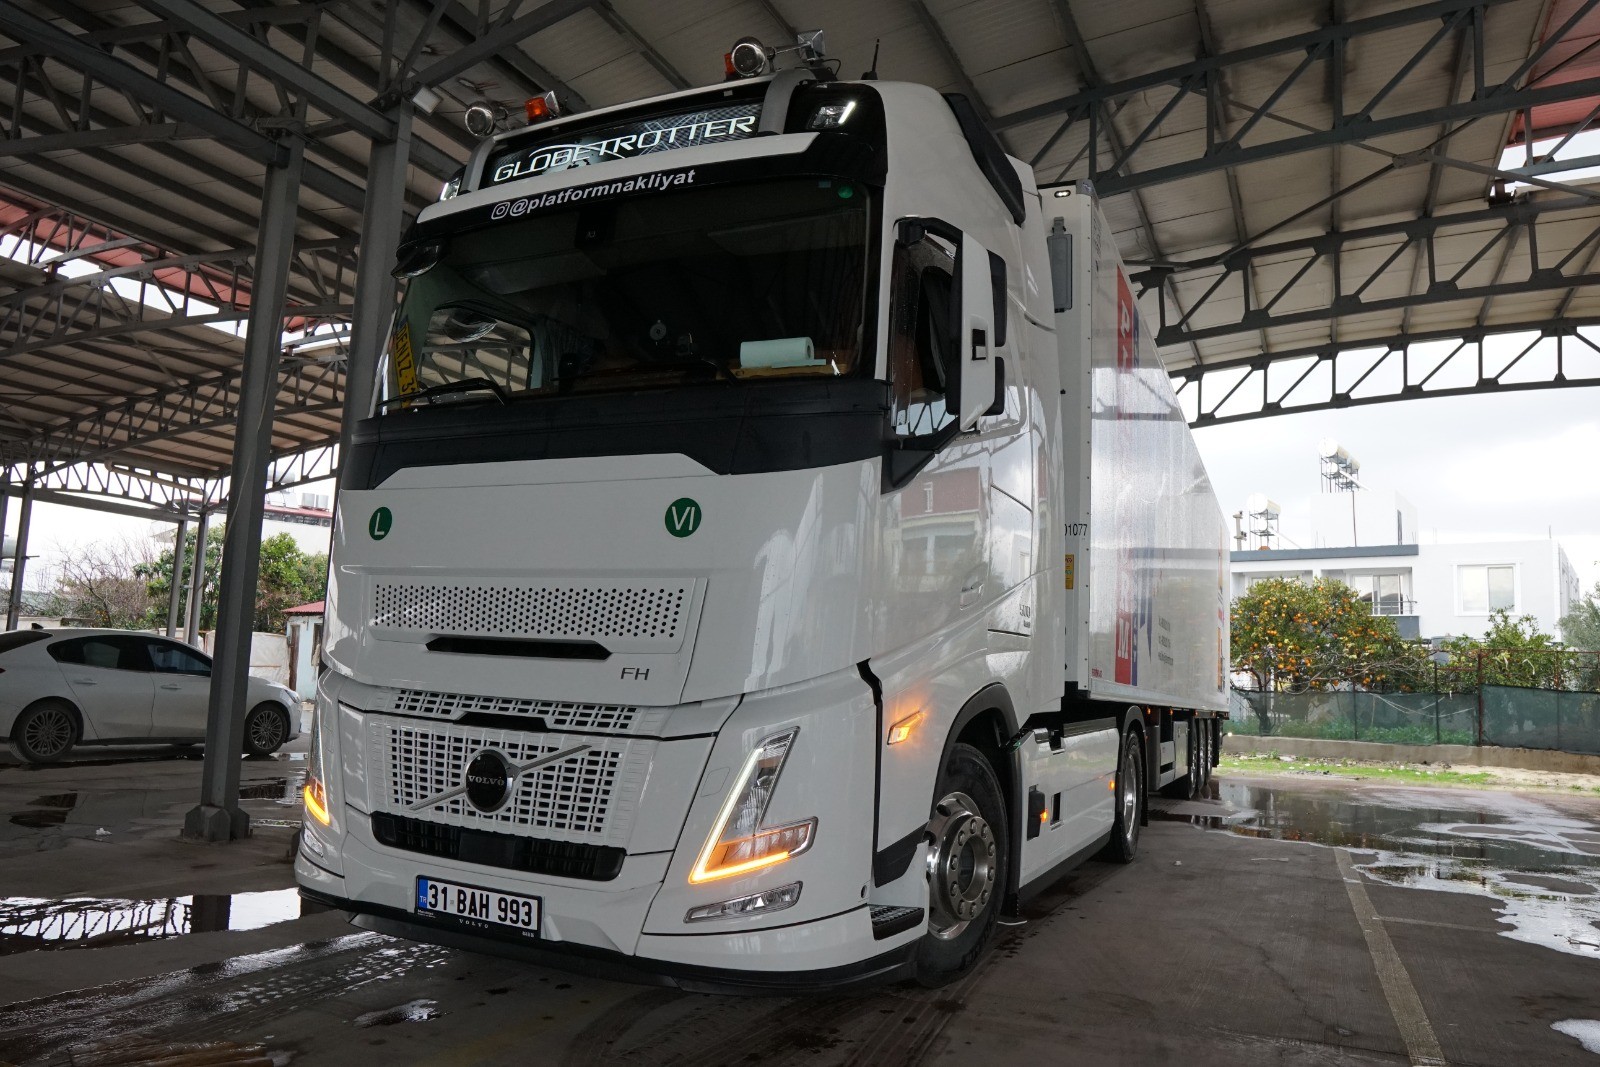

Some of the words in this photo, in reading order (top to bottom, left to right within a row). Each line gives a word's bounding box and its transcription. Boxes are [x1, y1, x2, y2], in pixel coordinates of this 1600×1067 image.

[494, 115, 756, 182] GLOBETROTTER
[509, 168, 696, 216] @platformnakliyat
[374, 512, 386, 536] L
[672, 506, 696, 531] VI
[620, 667, 650, 681] FH
[467, 774, 505, 786] VOLVO
[419, 895, 427, 903] TR
[428, 884, 448, 910] 31
[456, 889, 490, 919] BAH
[497, 897, 532, 927] 993
[458, 918, 489, 929] VOLVO
